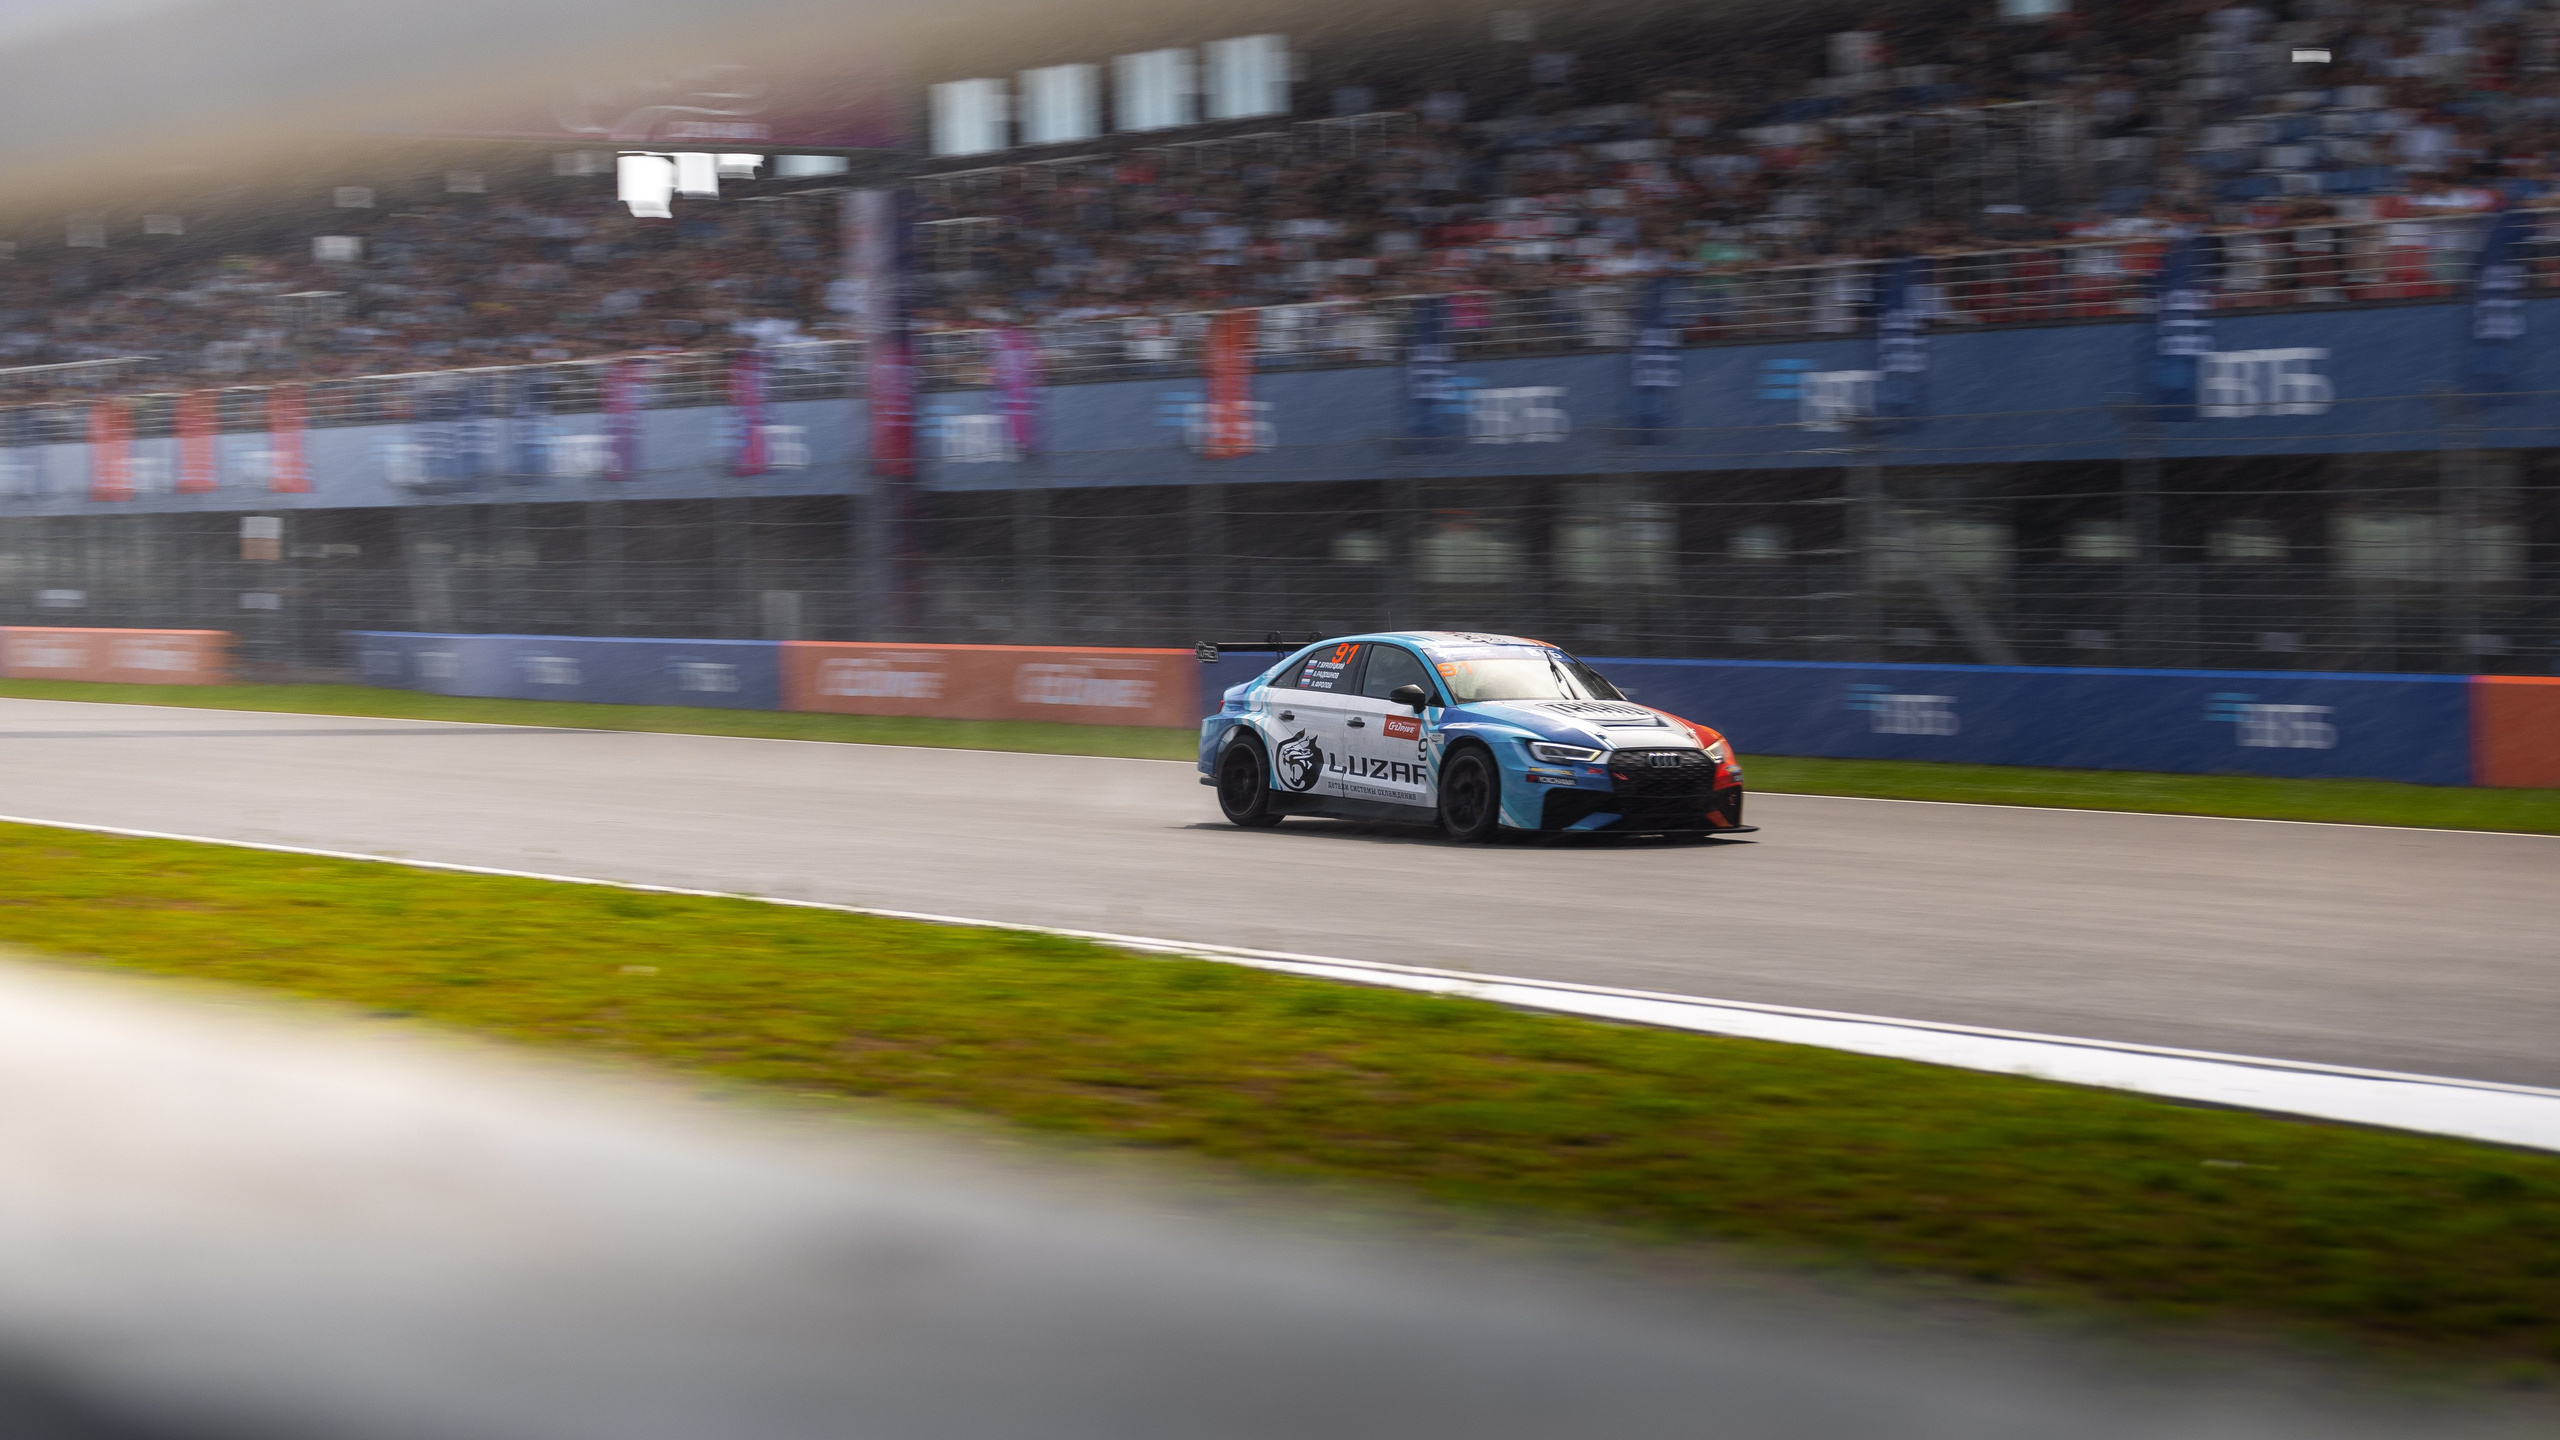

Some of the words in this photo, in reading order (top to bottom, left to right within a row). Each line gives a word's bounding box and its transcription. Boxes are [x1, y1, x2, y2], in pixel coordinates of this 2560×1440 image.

[1331, 643, 1360, 665] 91
[1437, 662, 1473, 677] 91
[1350, 784, 1376, 795] системы
[1377, 788, 1417, 800] охлаждения
